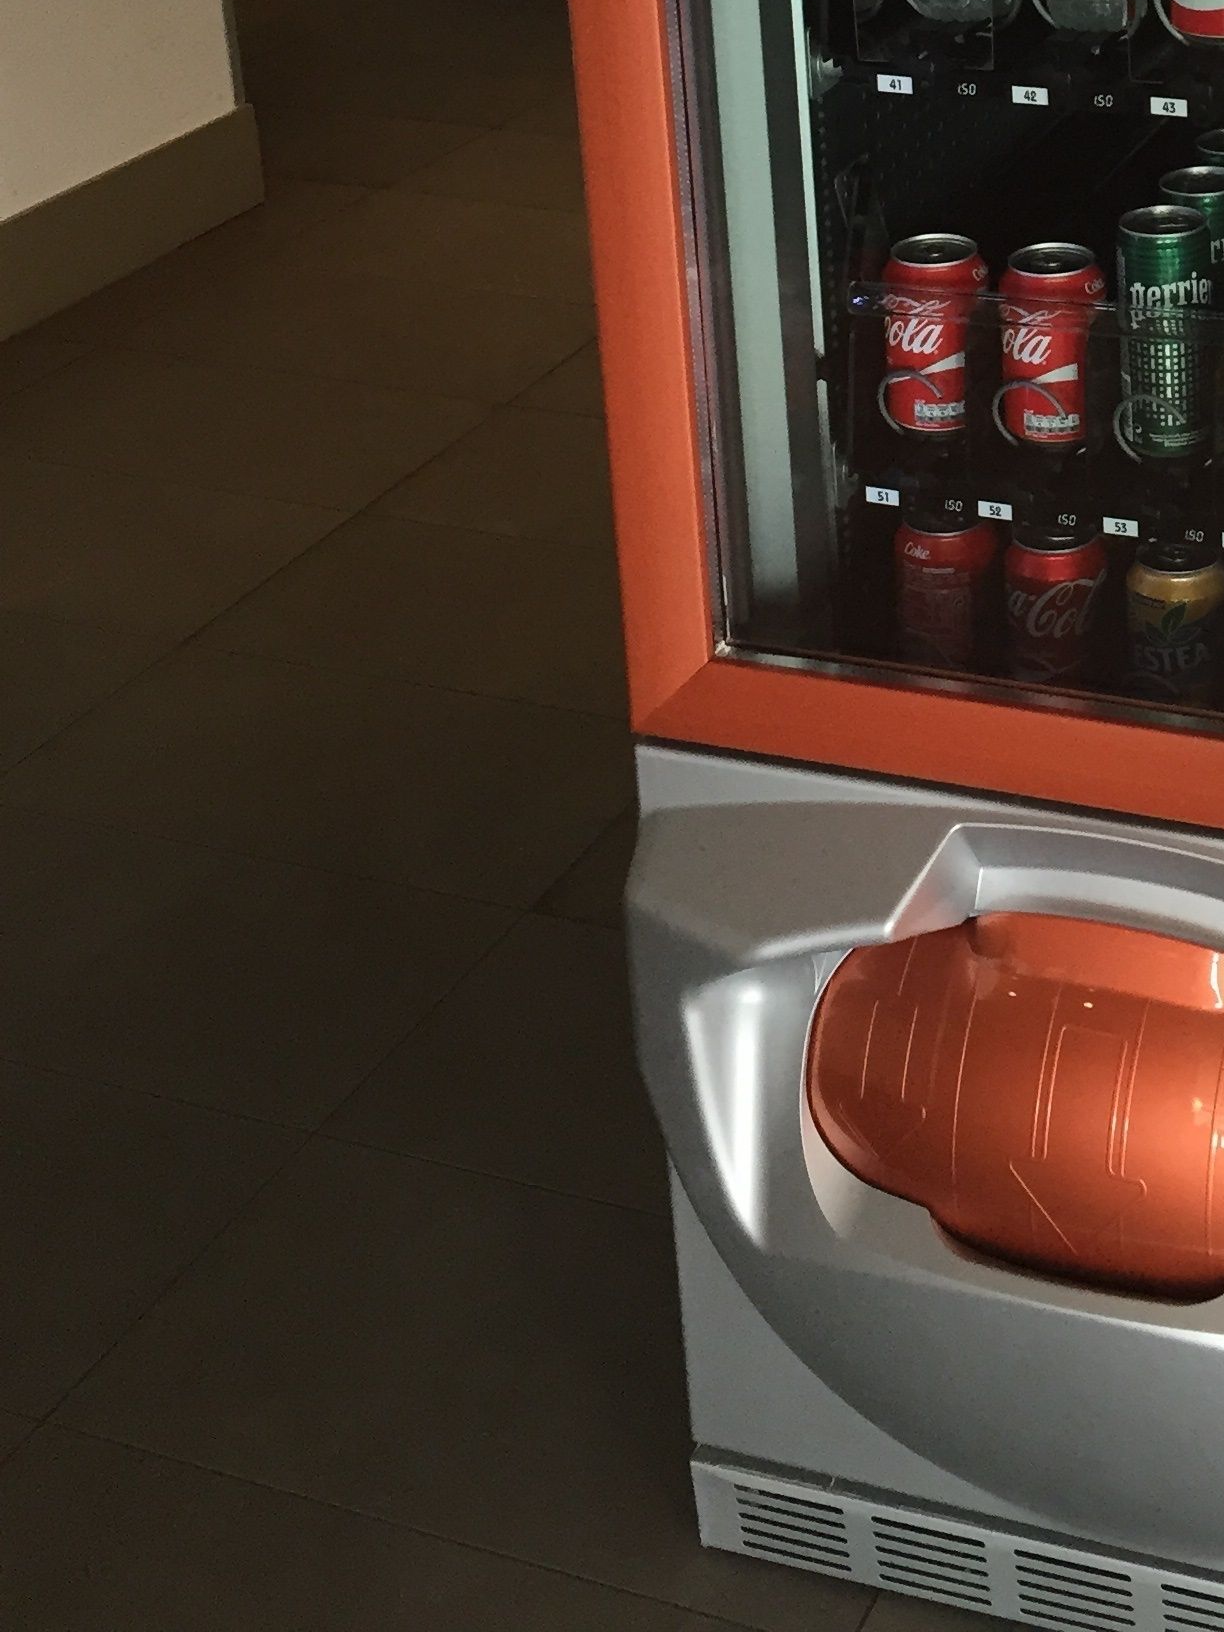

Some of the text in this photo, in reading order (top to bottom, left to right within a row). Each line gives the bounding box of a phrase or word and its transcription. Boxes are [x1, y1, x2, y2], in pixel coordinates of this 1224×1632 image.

[889, 79, 901, 91] 41
[1024, 90, 1037, 102] 42
[1162, 102, 1176, 113] 43
[877, 491, 889, 502] 51
[990, 506, 1001, 517] 52
[1115, 522, 1127, 533] 53
[904, 541, 931, 560] Coke
